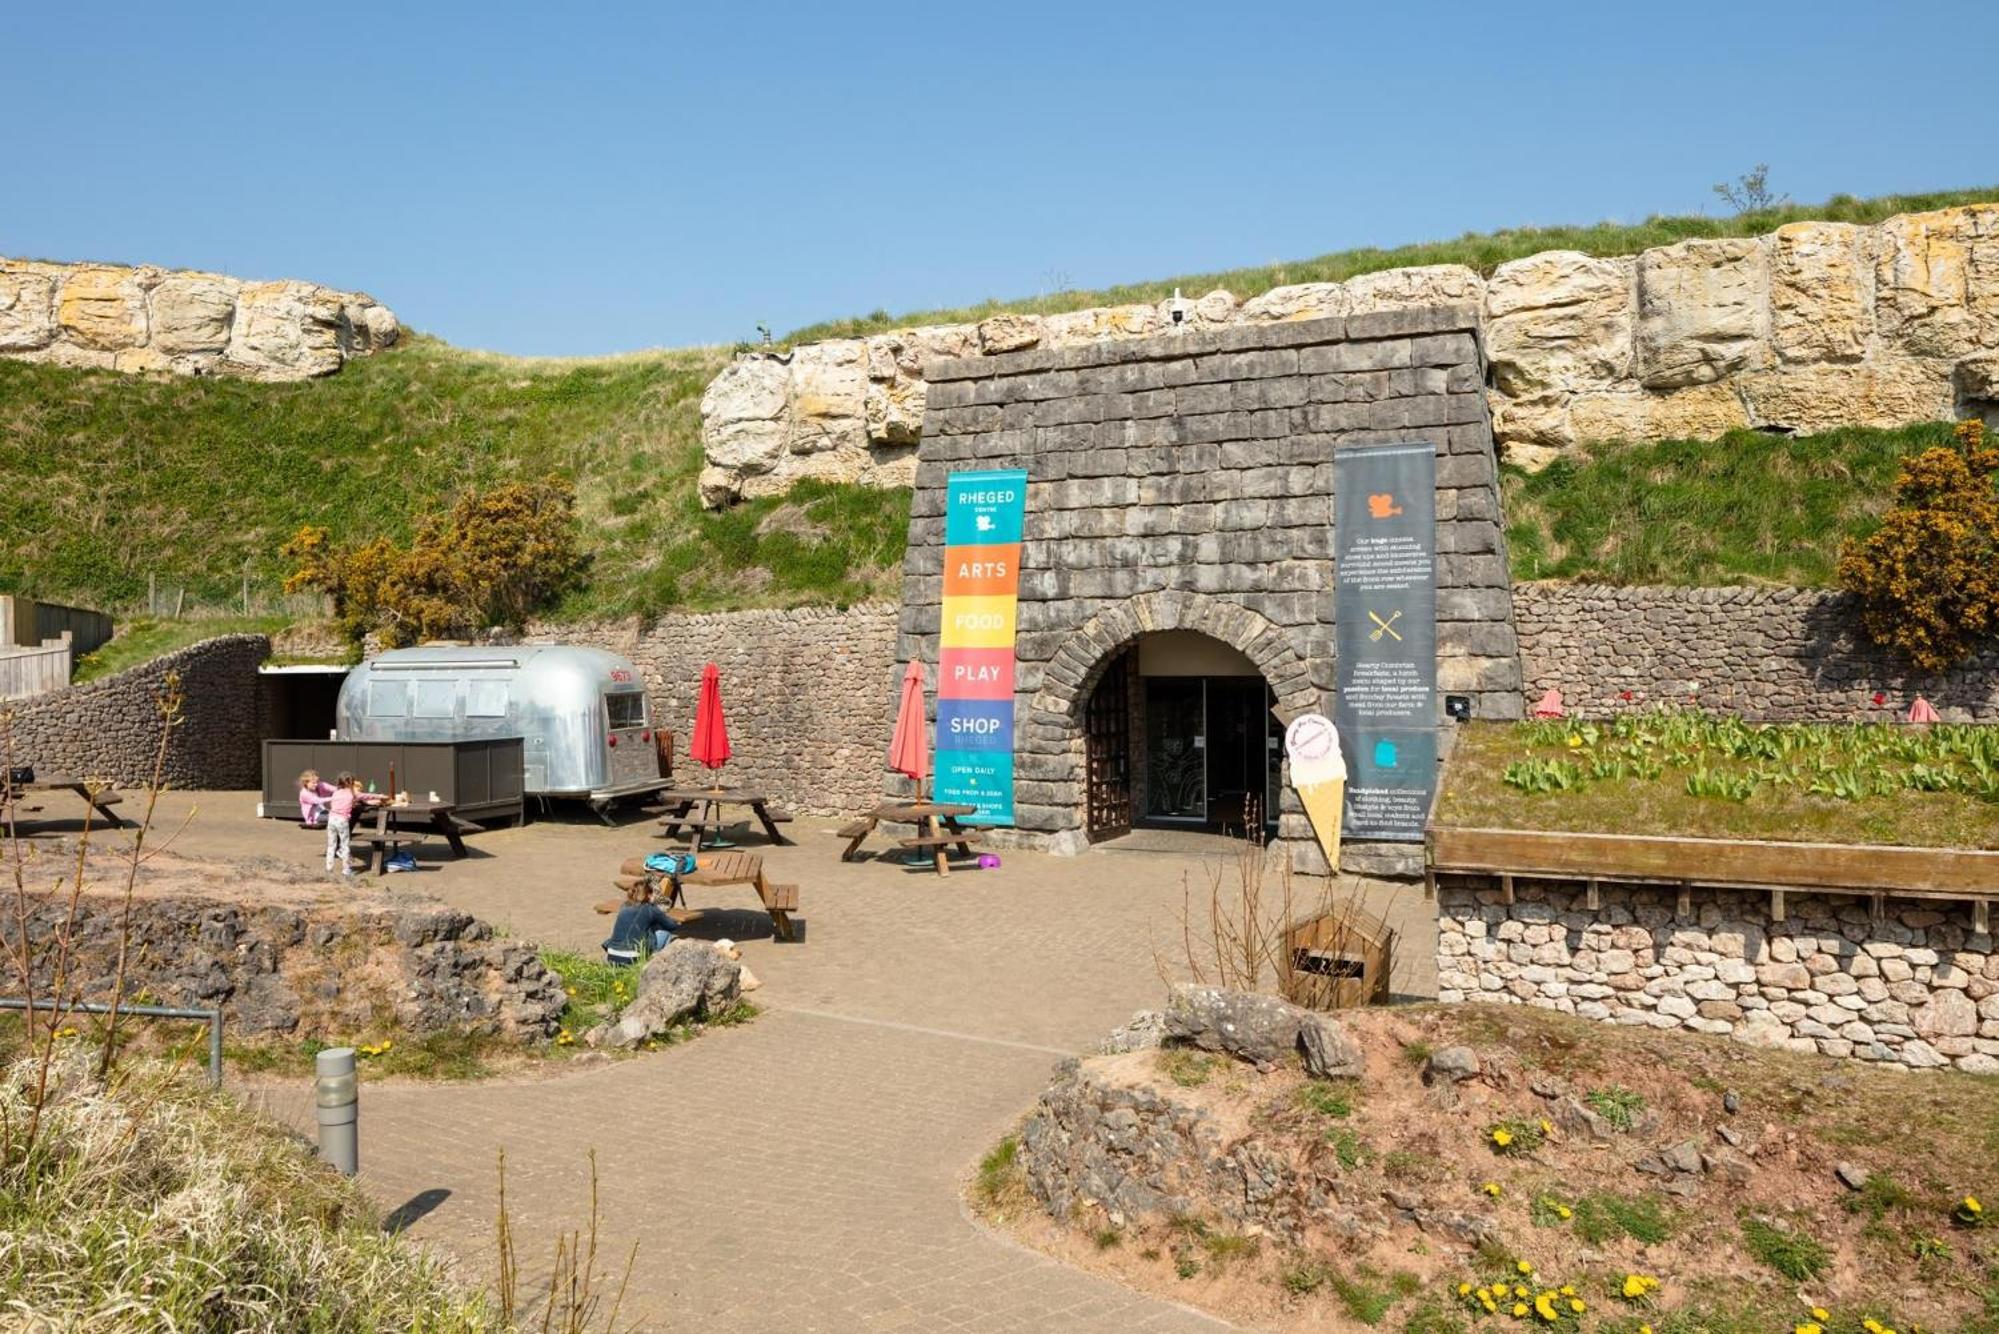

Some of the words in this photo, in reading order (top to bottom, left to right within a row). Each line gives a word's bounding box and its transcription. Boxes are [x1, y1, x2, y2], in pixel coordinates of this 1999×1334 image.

[959, 490, 1015, 504] RHEGED
[959, 562, 1006, 578] ARTS
[955, 613, 1005, 630] FOOD
[954, 665, 1000, 681] PLAY
[950, 718, 1000, 734] SHOP
[951, 766, 973, 774] OPEN
[974, 767, 995, 775] DAILY
